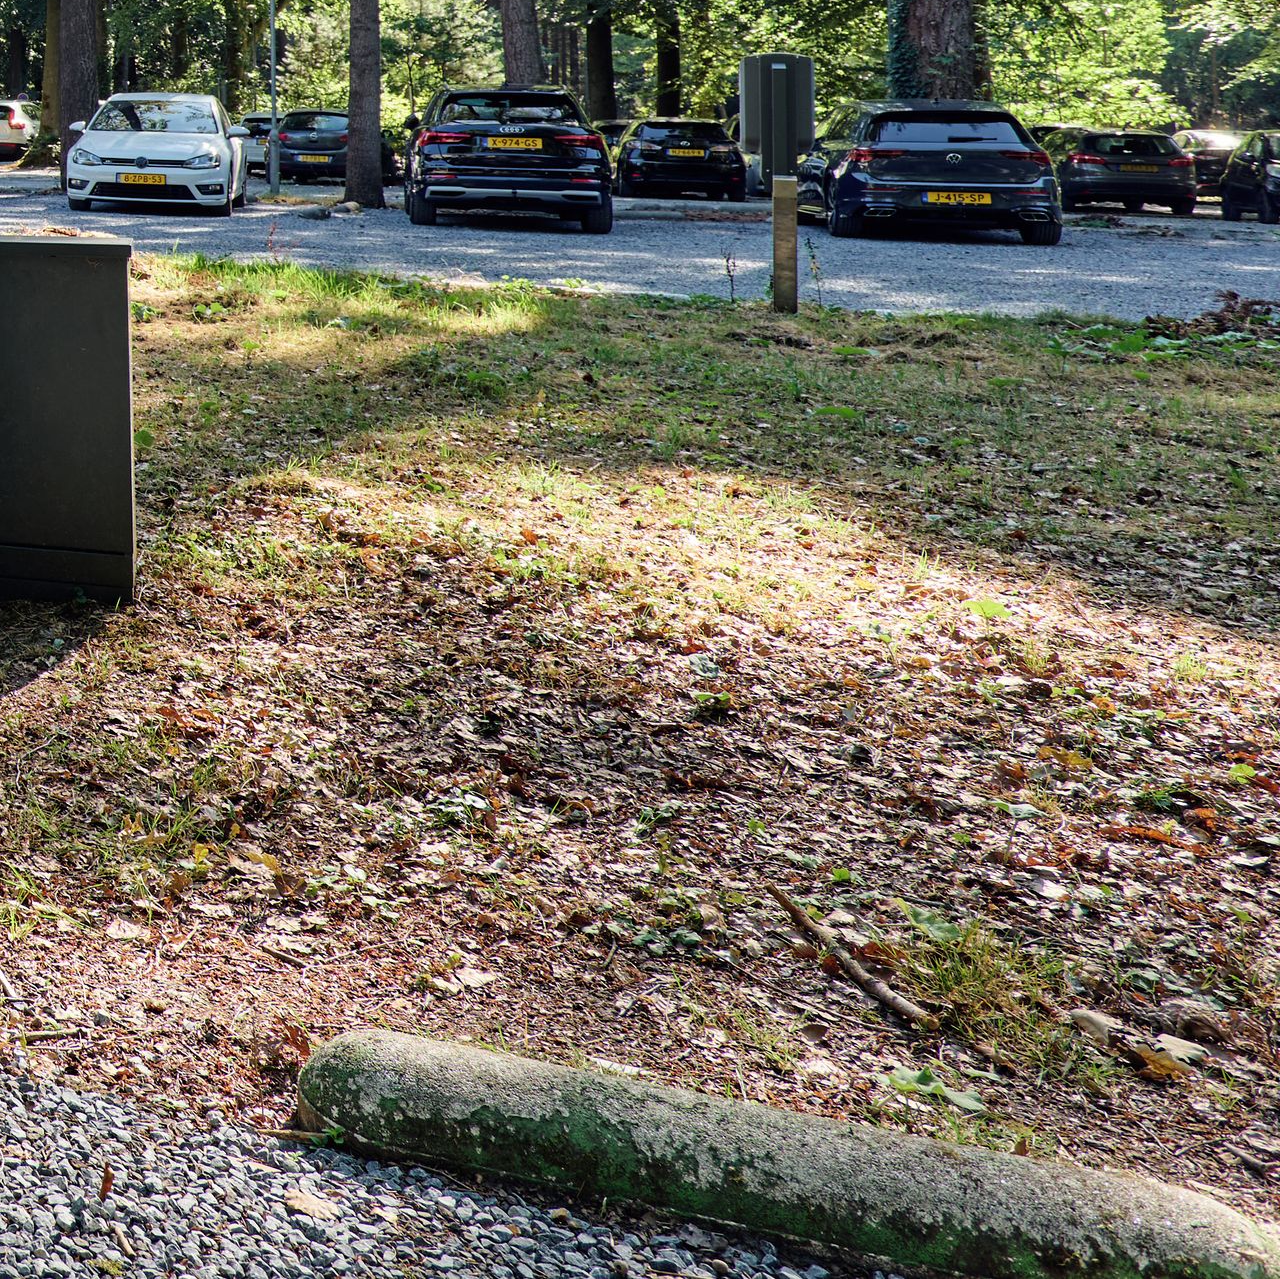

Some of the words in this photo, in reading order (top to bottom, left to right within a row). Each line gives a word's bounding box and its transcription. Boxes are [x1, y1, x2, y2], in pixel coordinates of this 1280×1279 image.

[491, 138, 538, 147] X-974-GS
[124, 174, 162, 183] 8-ZPB-53
[935, 193, 985, 202] J-415-SP
